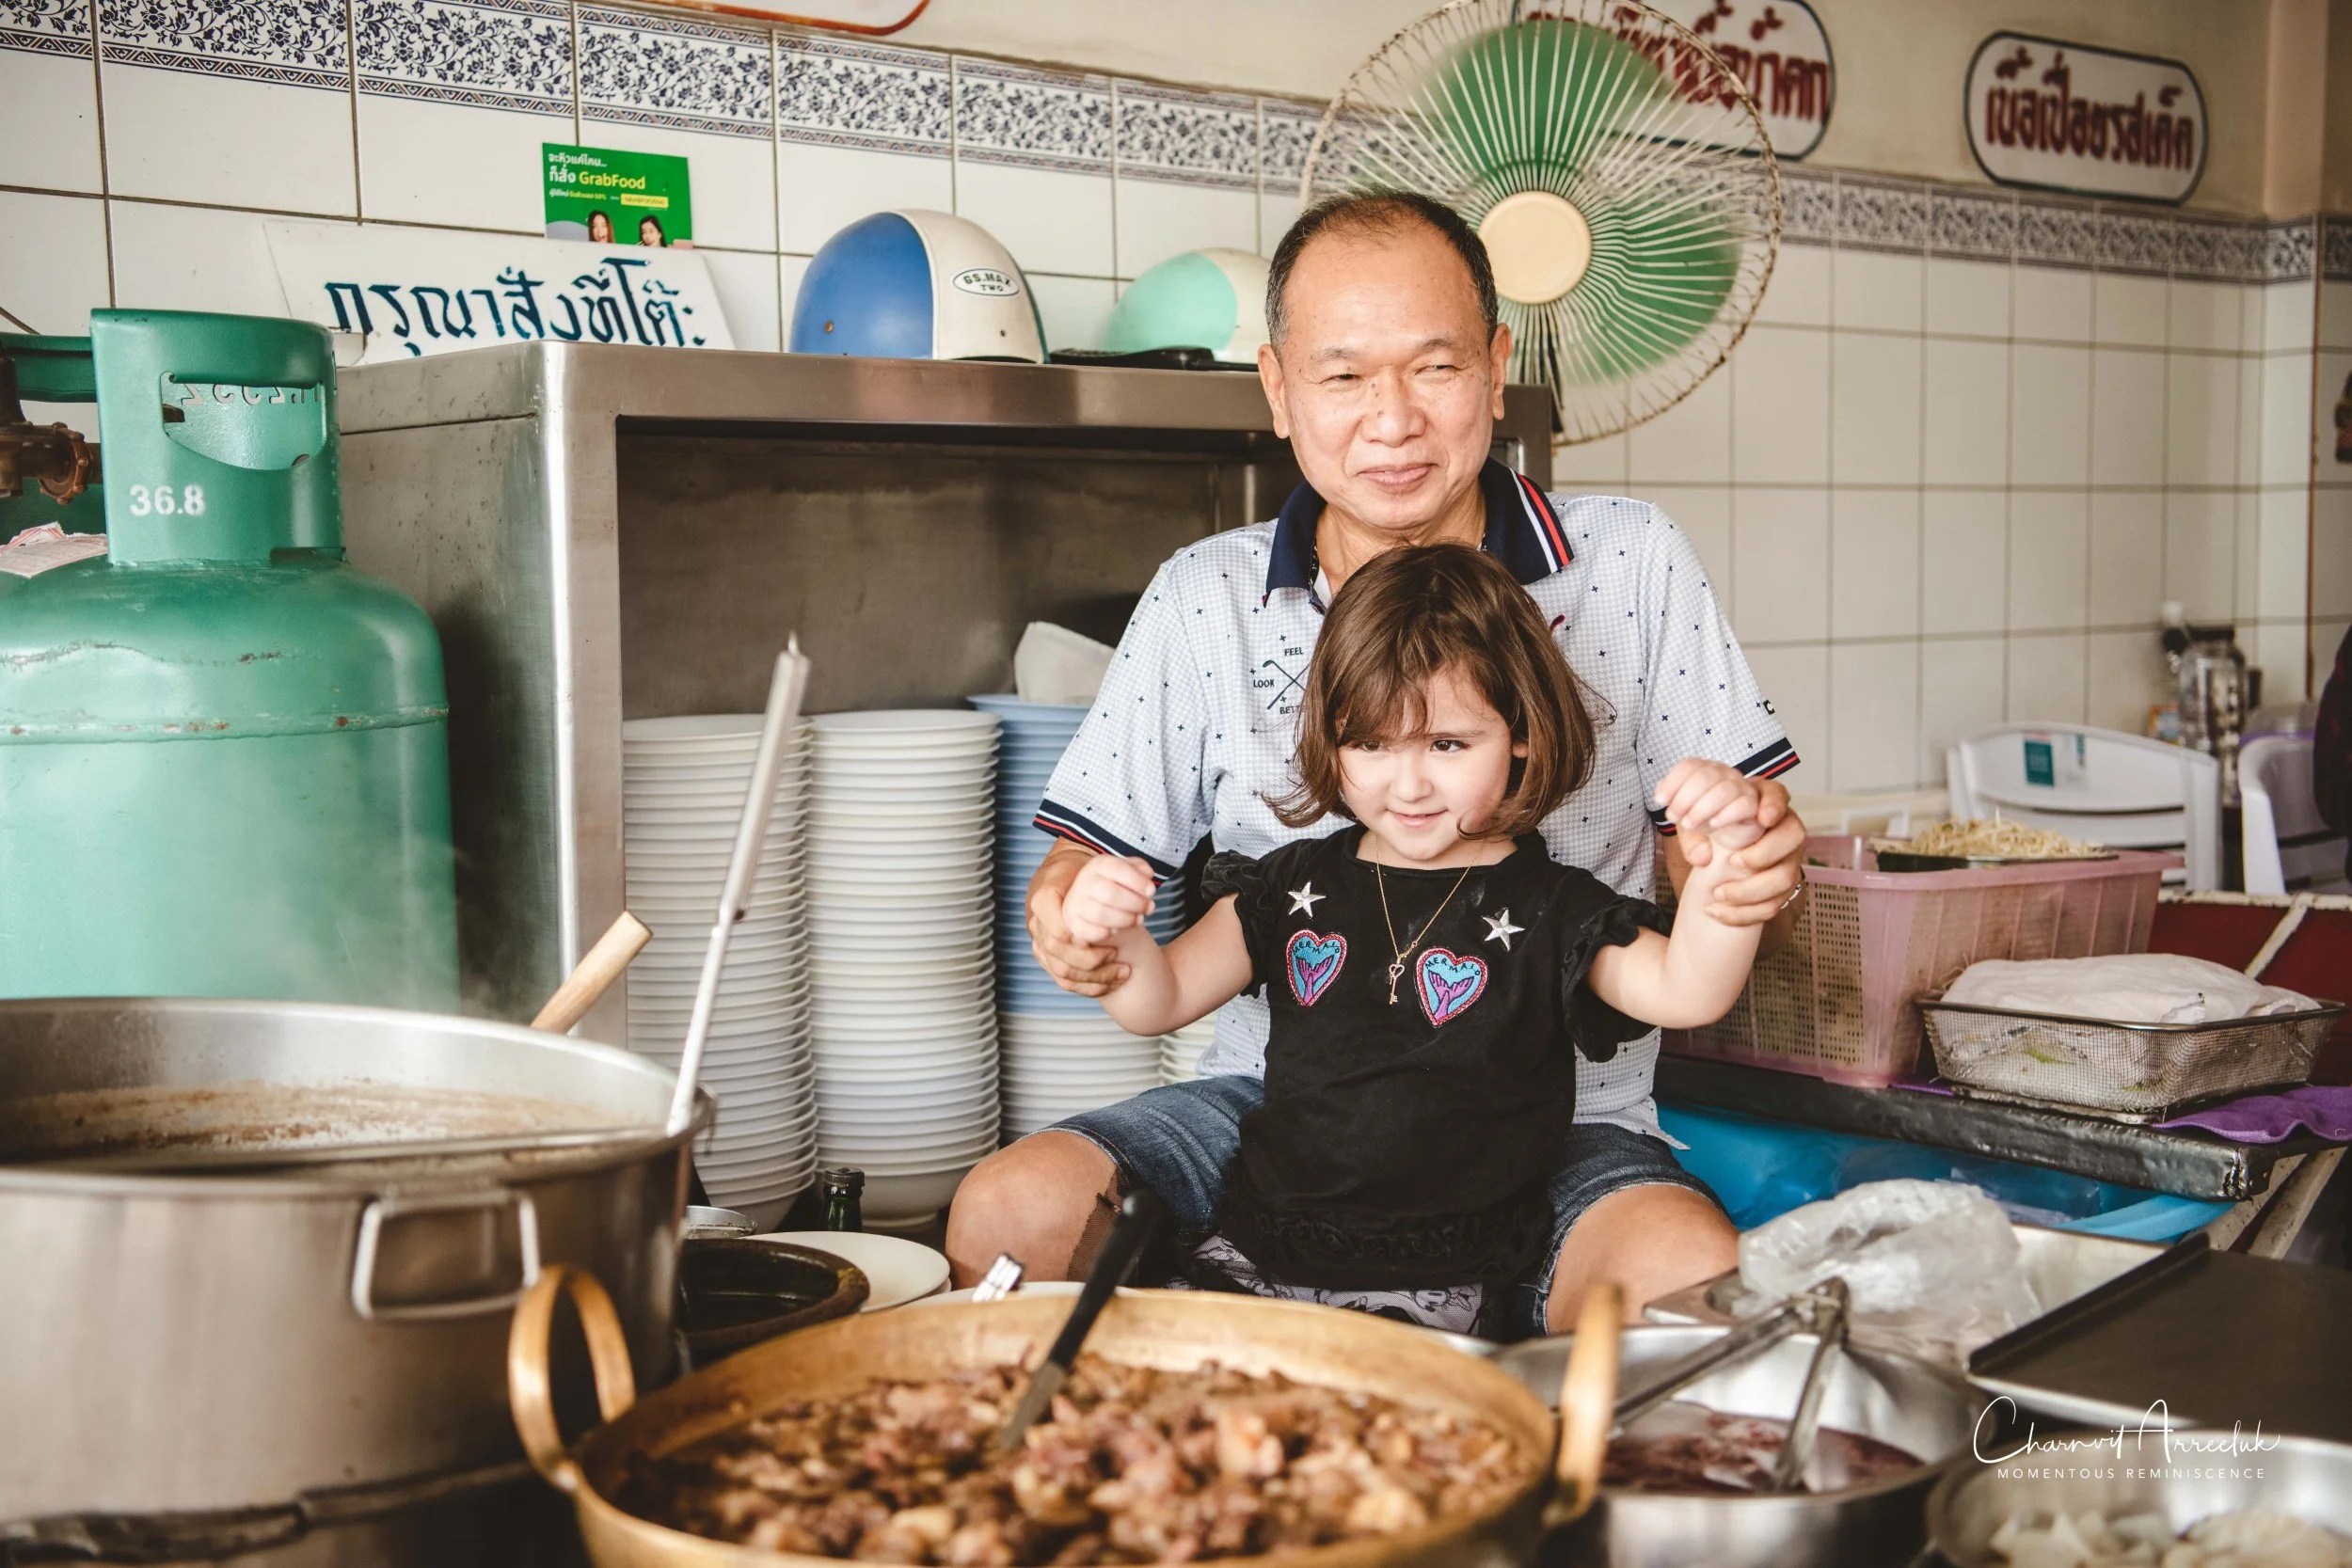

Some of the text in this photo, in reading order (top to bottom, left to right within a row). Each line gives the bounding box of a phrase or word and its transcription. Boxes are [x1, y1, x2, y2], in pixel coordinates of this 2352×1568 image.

[548, 163, 646, 189] ก็สั่ง GrabFood
[979, 283, 1004, 292] TWO
[324, 257, 707, 356] กรุณาสั่งที่โต๊ะ
[129, 484, 205, 515] 36.8
[1284, 647, 1304, 656] FEEL
[1253, 679, 1275, 688] LOOK
[1293, 940, 1341, 955] MERMAID
[1425, 957, 1481, 976] MERMAID
